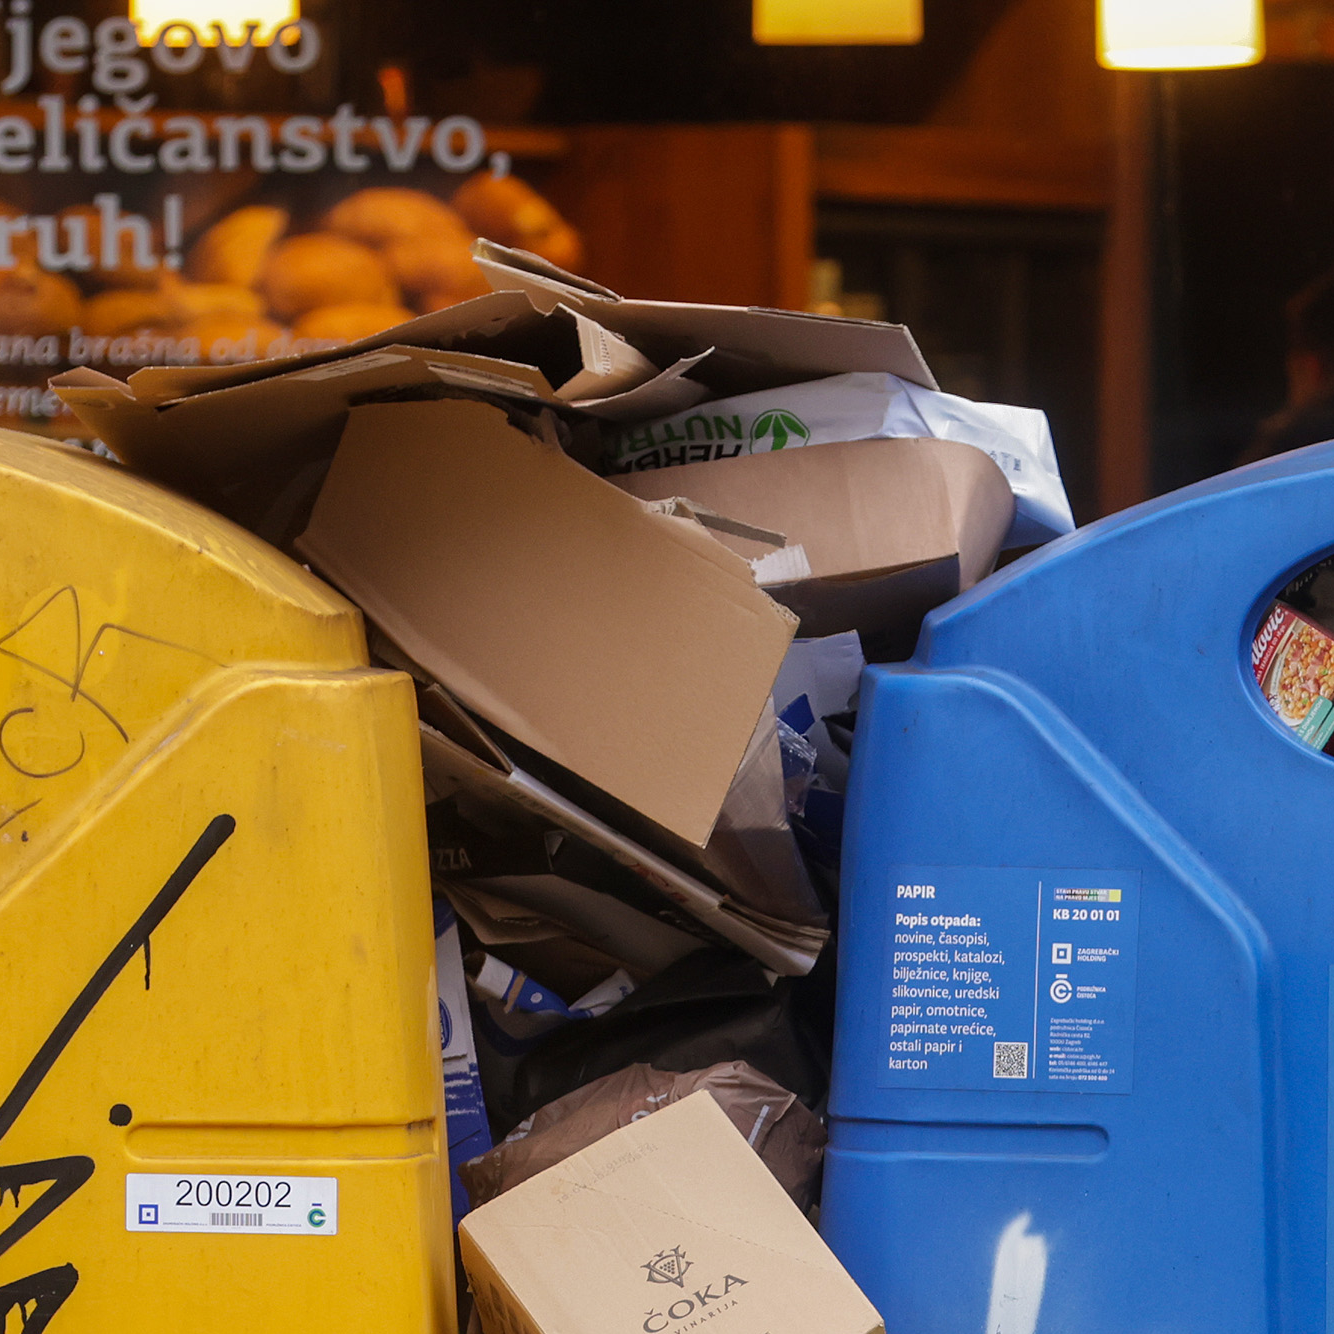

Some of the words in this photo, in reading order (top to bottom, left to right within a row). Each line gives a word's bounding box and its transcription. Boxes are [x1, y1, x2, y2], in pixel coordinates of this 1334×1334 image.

[69, 325, 202, 366] brašna
[897, 885, 936, 898] PAPIR
[896, 913, 929, 928] Popis
[930, 914, 981, 927] otpada:
[1053, 908, 1070, 920] KB
[1072, 909, 1087, 920] 20
[1090, 909, 1104, 921] 01
[1106, 910, 1120, 921] 01
[895, 932, 936, 946] novine,
[938, 932, 990, 947] časopisi,
[894, 950, 951, 965] prospekti,
[954, 951, 1005, 965] katalozi,
[893, 967, 949, 982] bilježnice,
[952, 968, 992, 984] knjige,
[892, 985, 952, 1000] slikovnice,
[954, 986, 1000, 1000] uredski
[891, 1004, 923, 1018] papir,
[926, 1005, 987, 1018] omotnice,
[890, 1022, 947, 1037] papirnate
[950, 1022, 997, 1037] vrećice,
[889, 1040, 922, 1052] ostali
[924, 1040, 955, 1054] papir
[889, 1057, 928, 1070] karton
[175, 1180, 292, 1208] 200202
[643, 1274, 749, 1334] ČOKA
